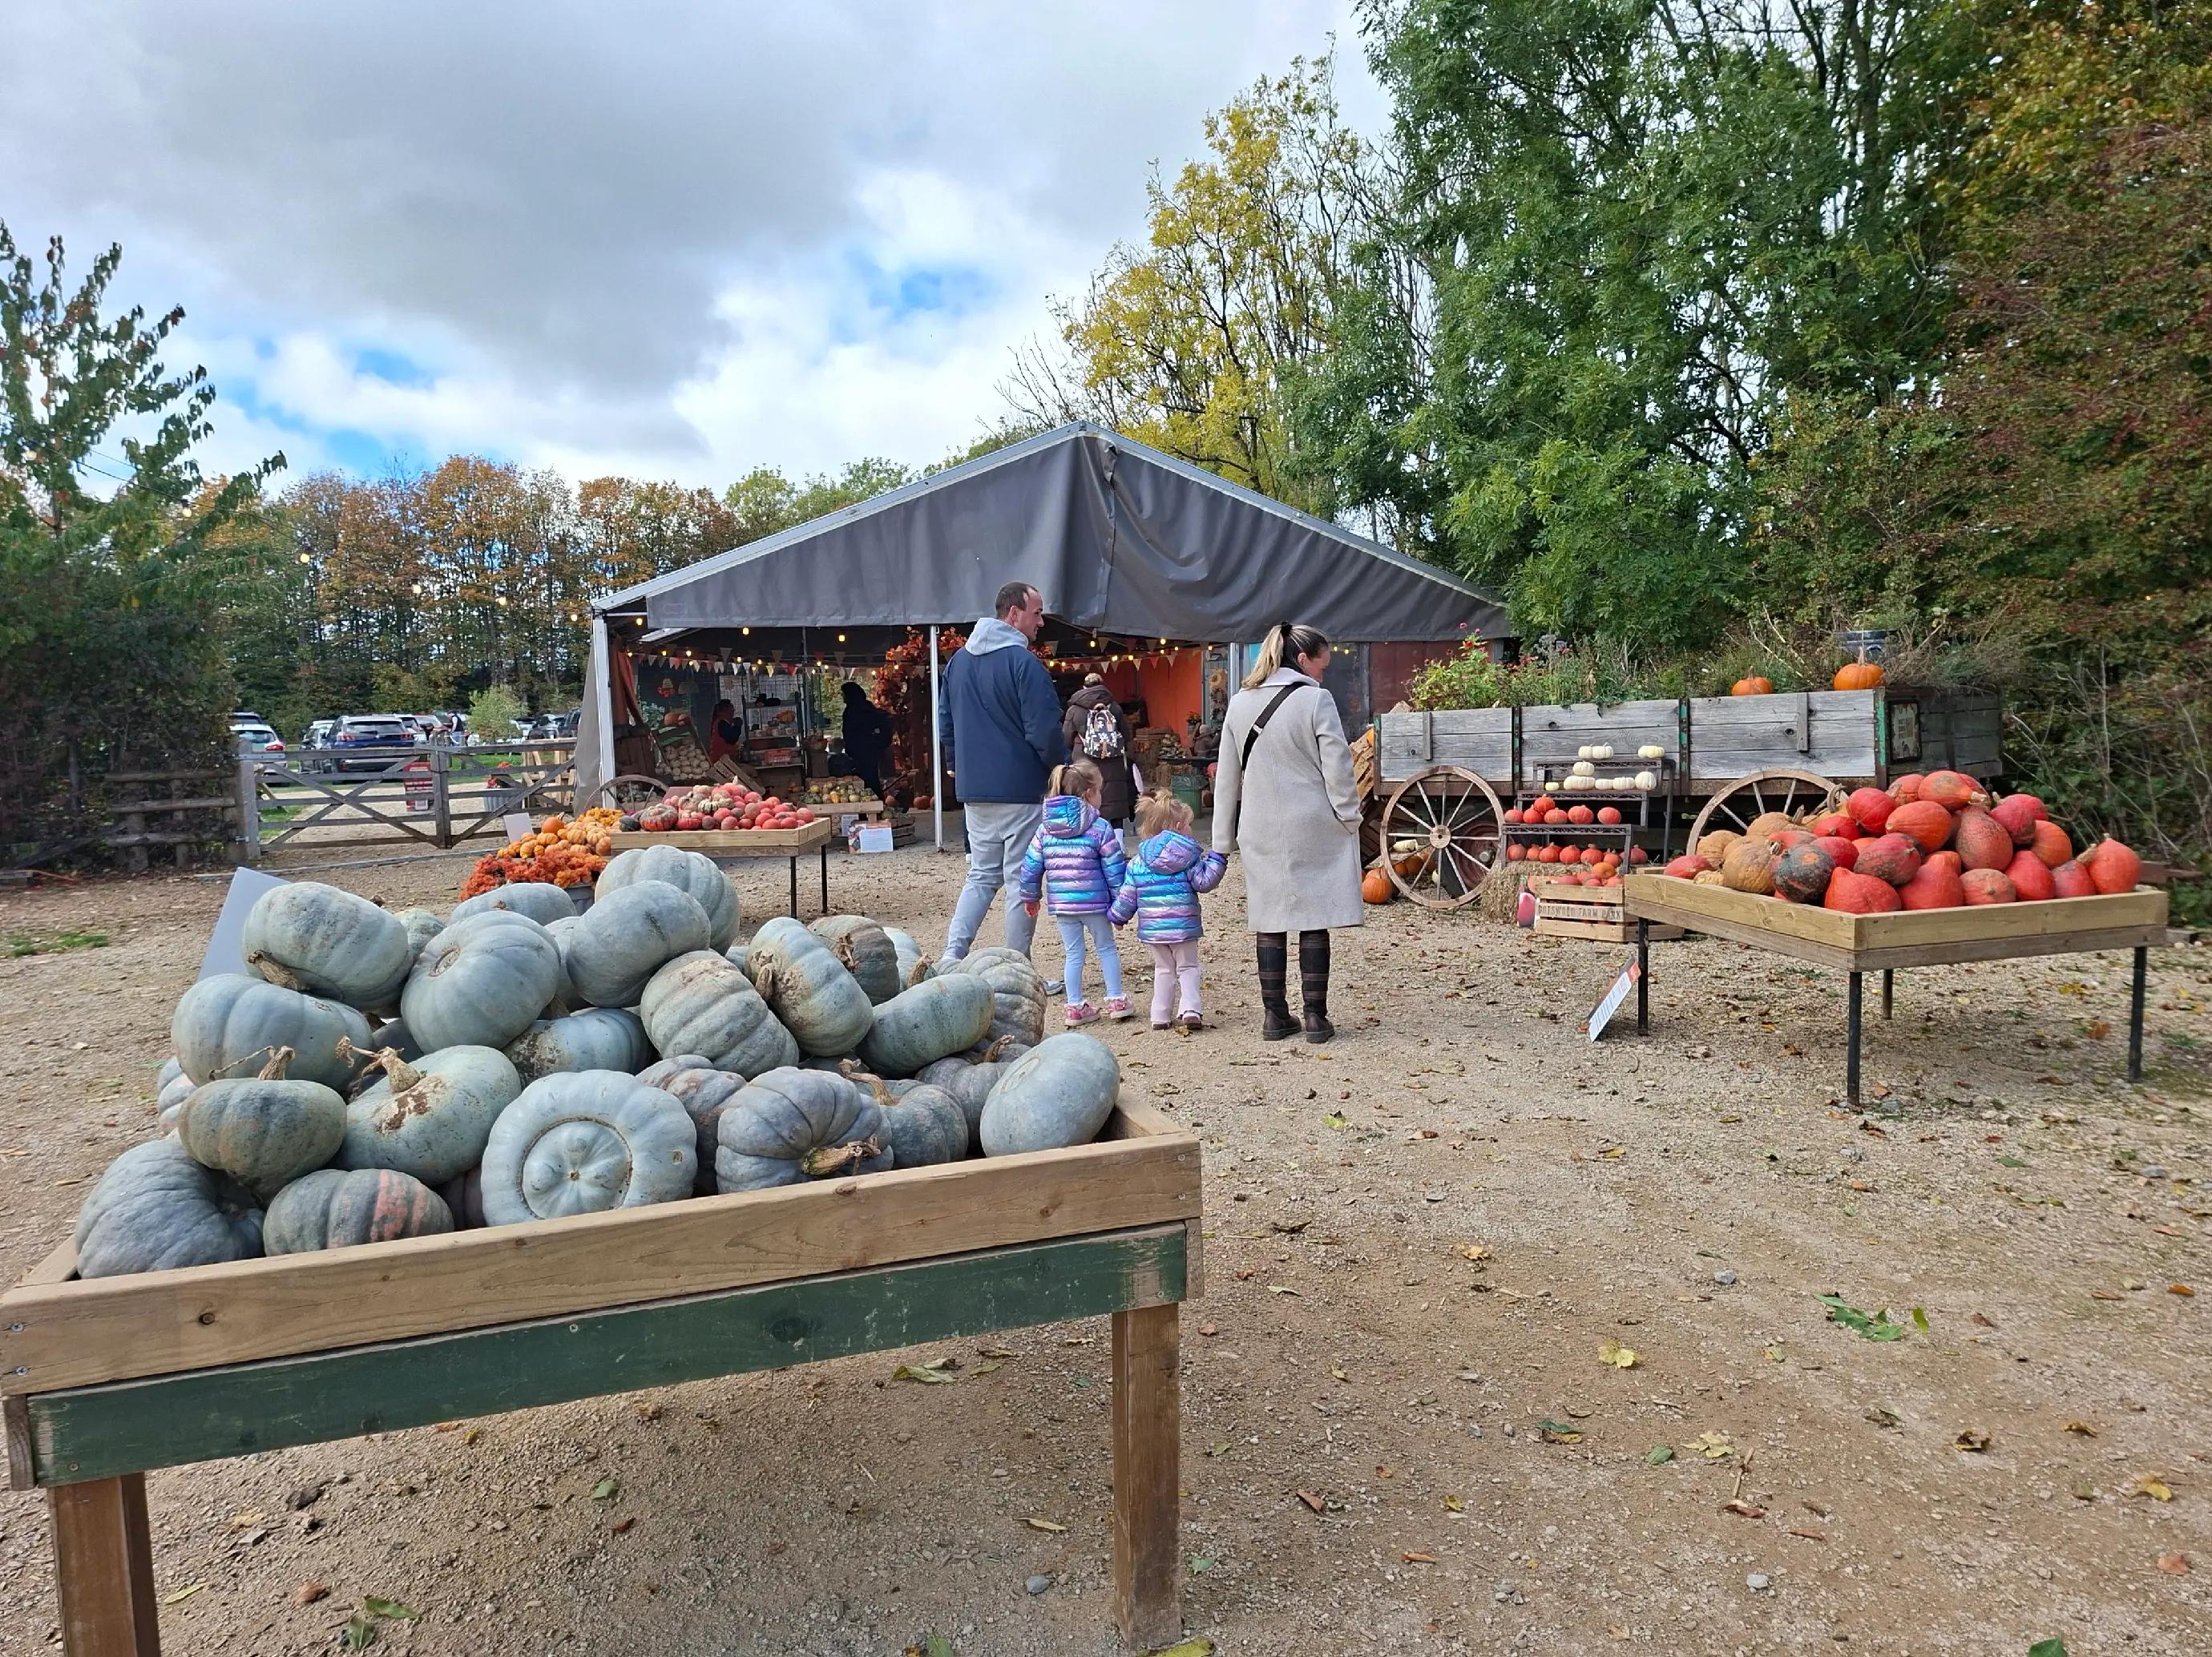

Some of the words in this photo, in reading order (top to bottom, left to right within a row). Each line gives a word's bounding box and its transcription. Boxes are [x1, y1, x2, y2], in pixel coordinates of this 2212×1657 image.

[1538, 905, 1576, 917] COTSWOLD
[1579, 907, 1598, 918] FARM
[1601, 909, 1622, 921] PARK
